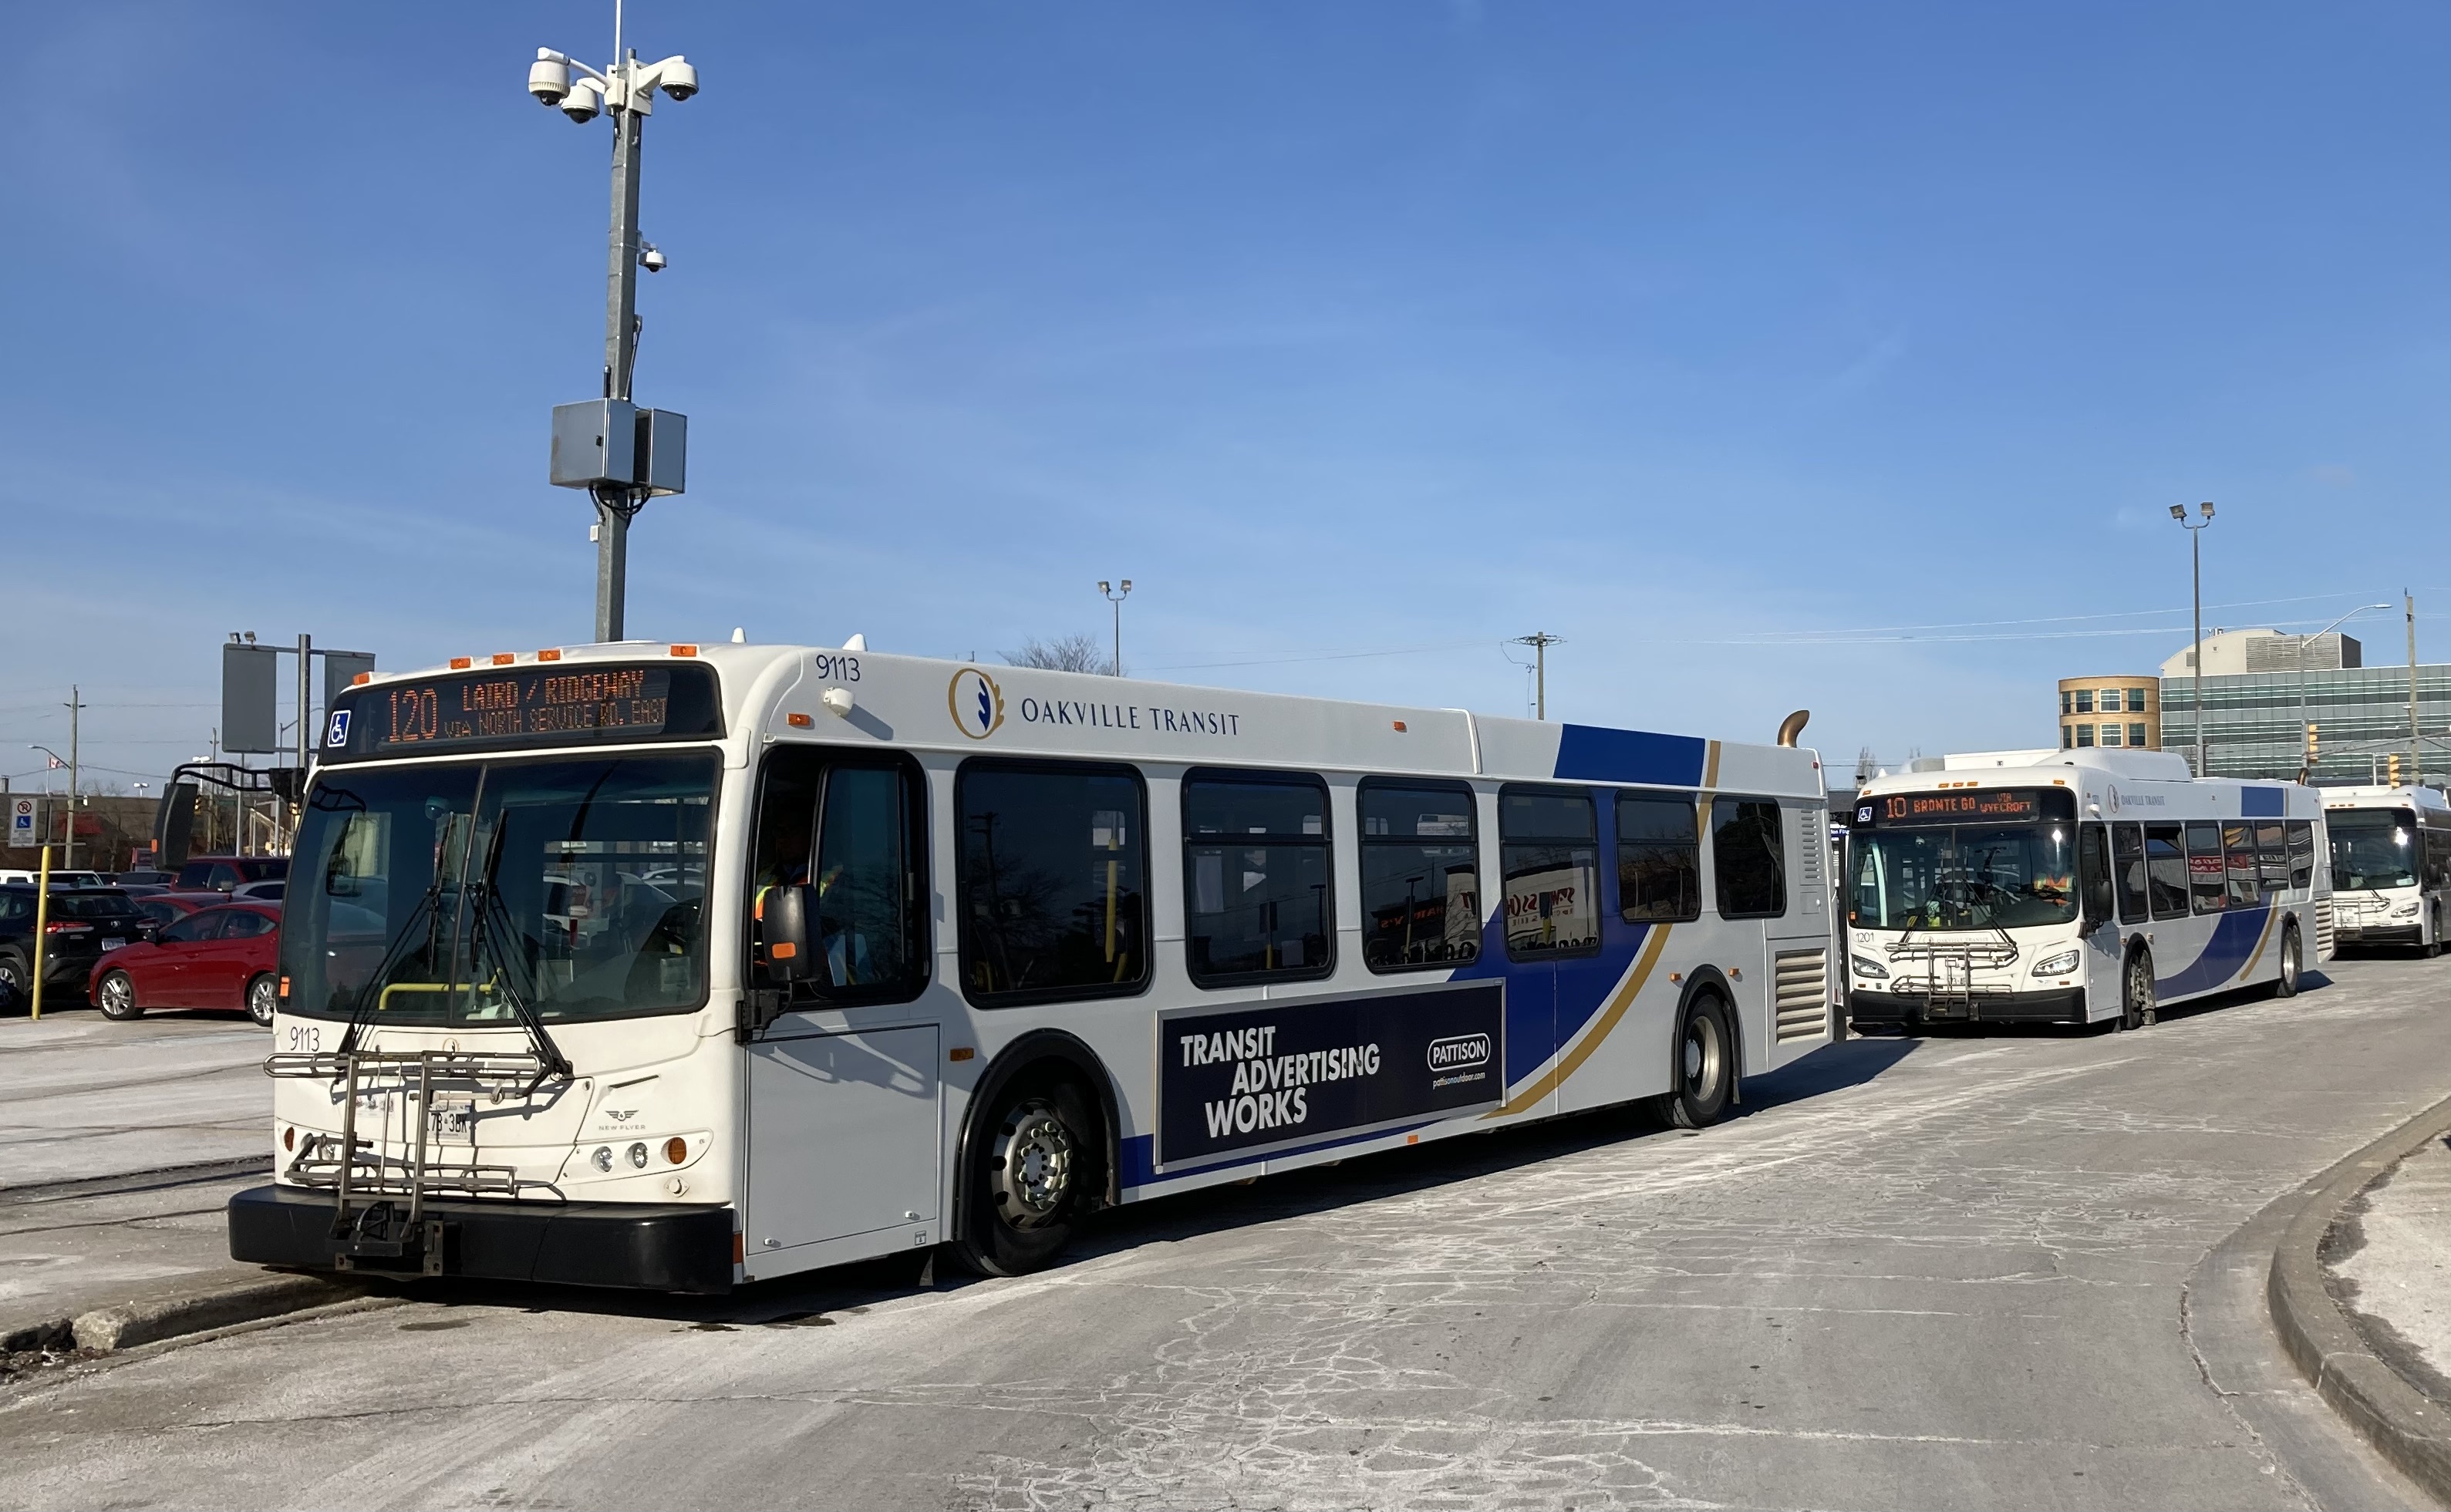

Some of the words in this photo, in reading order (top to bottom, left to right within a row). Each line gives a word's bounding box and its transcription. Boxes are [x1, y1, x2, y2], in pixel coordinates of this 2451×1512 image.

[816, 655, 861, 682] 9113
[462, 681, 520, 712] LAIRD
[545, 669, 645, 705] RIDGEWAY
[389, 688, 438, 743] 120
[443, 720, 473, 739] VIA
[478, 709, 523, 736] NORTH
[529, 702, 593, 732] SERVICE
[631, 697, 668, 724] EAST
[1021, 697, 1141, 729] OAKVILLE
[1148, 707, 1239, 736] TRANSIT
[1886, 796, 1907, 818] 10
[1913, 799, 1957, 813] BRONTE
[1960, 797, 1976, 810] GO
[1979, 801, 2032, 813] WYECROFT
[1996, 793, 2012, 802] VIA
[1856, 932, 1874, 943] 1201
[290, 1026, 320, 1052] 9113
[1181, 1025, 1276, 1066] TRANSIT
[1433, 1040, 1485, 1064] PATTISON
[1231, 1043, 1381, 1096] ADVERTISING
[1432, 1071, 1485, 1089] pattisonoutdoor.com
[1205, 1087, 1307, 1138] WORKS
